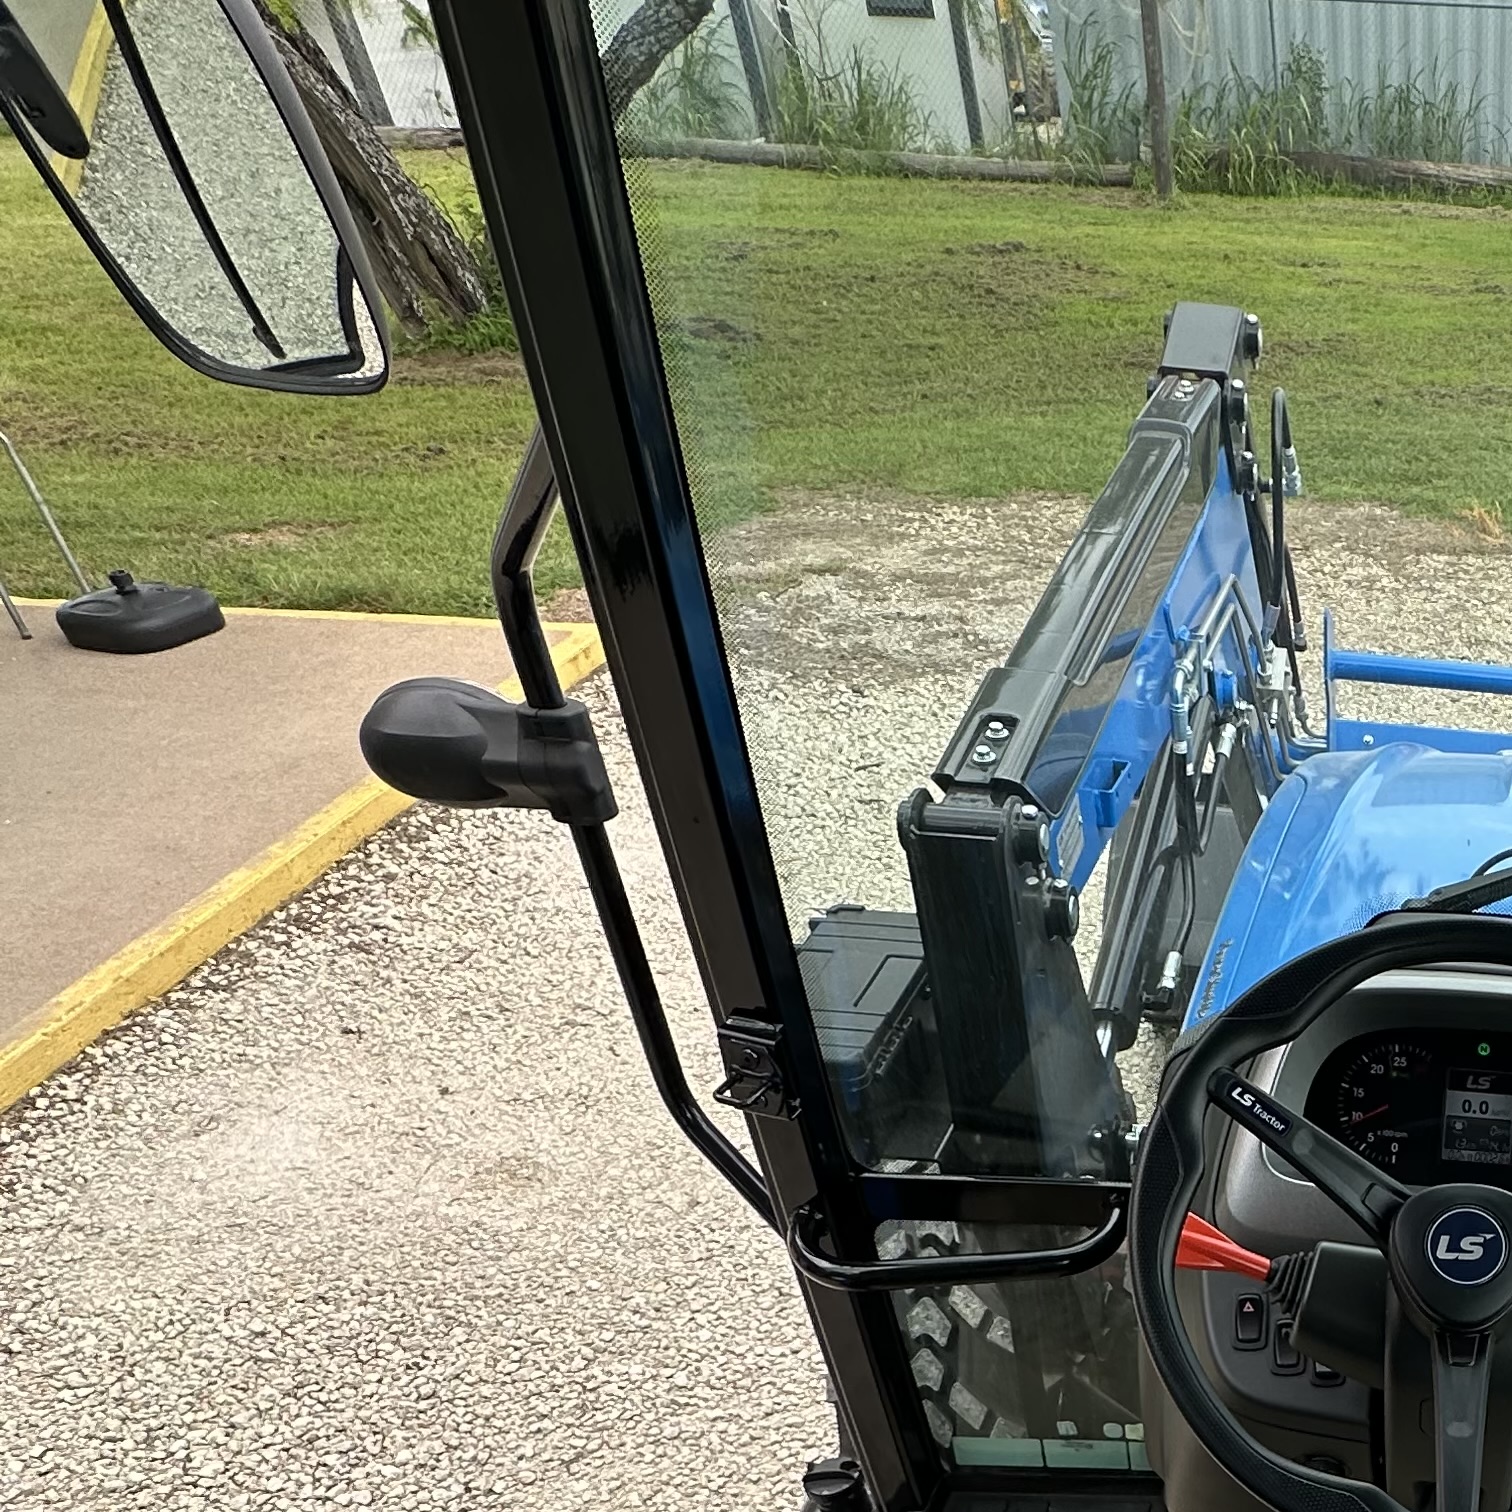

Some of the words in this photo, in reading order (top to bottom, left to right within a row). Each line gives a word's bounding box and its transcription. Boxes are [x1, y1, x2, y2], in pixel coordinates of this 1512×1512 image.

[1393, 1056, 1407, 1066] 25
[1370, 1064, 1384, 1074] 20
[1466, 1075, 1496, 1089] LS
[1352, 1087, 1365, 1098] 15
[1231, 1086, 1256, 1107] LS
[1253, 1103, 1286, 1131] Tractor
[1462, 1099, 1489, 1115] 0.0
[1351, 1111, 1364, 1121] 10
[1367, 1132, 1375, 1142] 5
[1391, 1143, 1399, 1152] 0
[1436, 1233, 1496, 1260] LS
